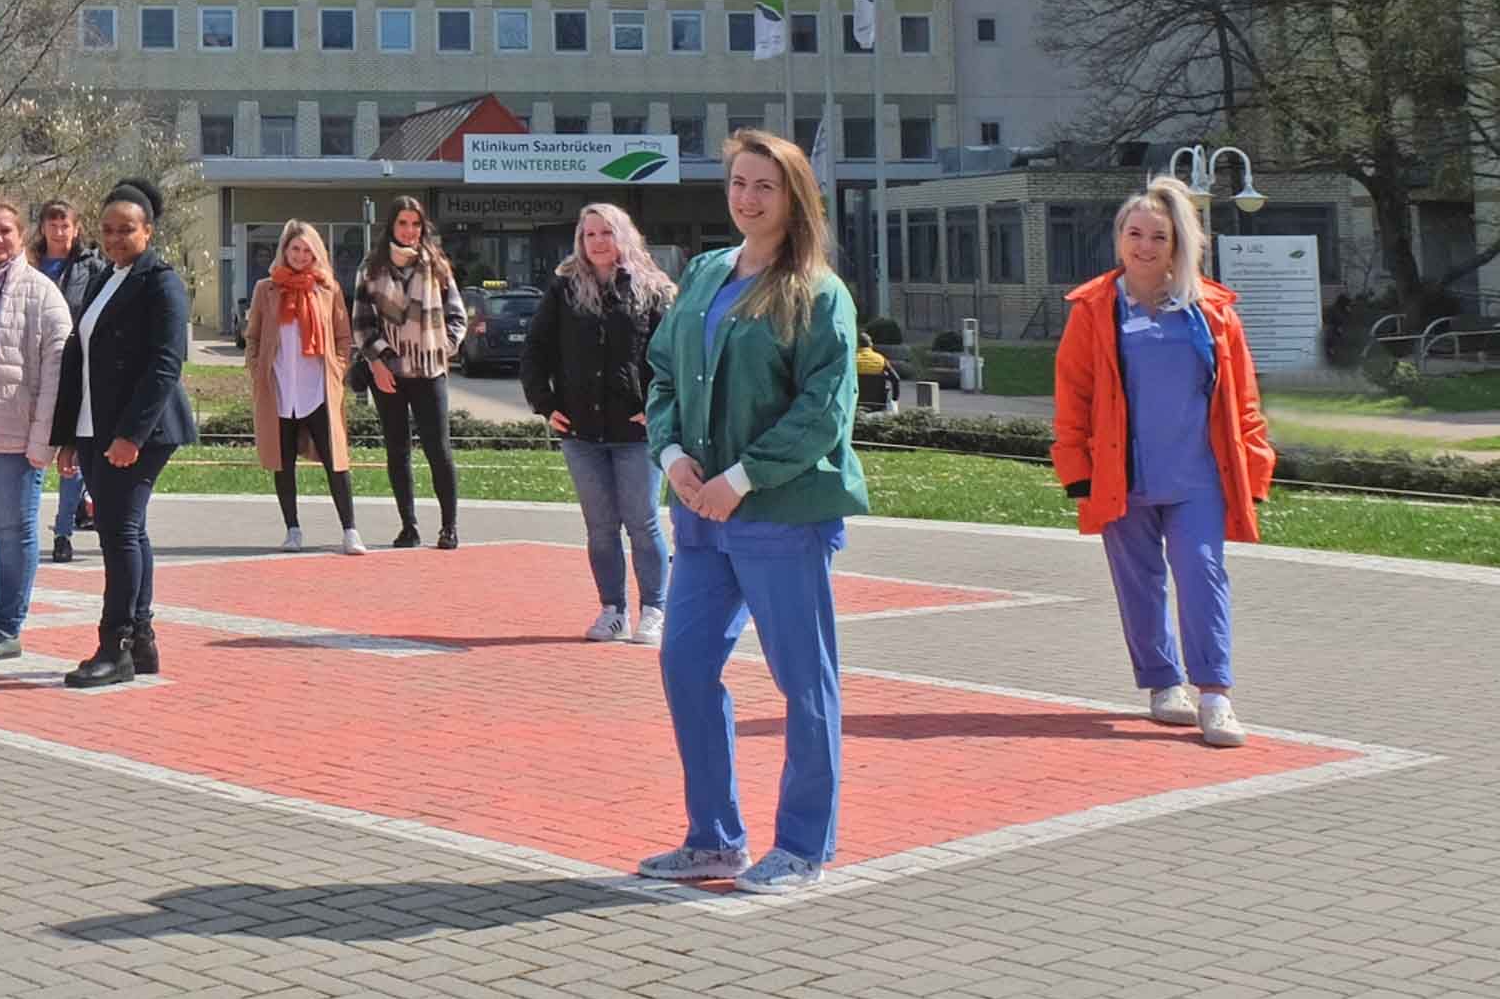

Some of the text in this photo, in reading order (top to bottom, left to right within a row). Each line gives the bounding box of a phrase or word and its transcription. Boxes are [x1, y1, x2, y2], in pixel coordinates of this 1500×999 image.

[471, 140, 612, 153] Klinikum Saarbrücken
[472, 159, 587, 171] DER WINTERBERG
[447, 196, 564, 216] Haupteingang
